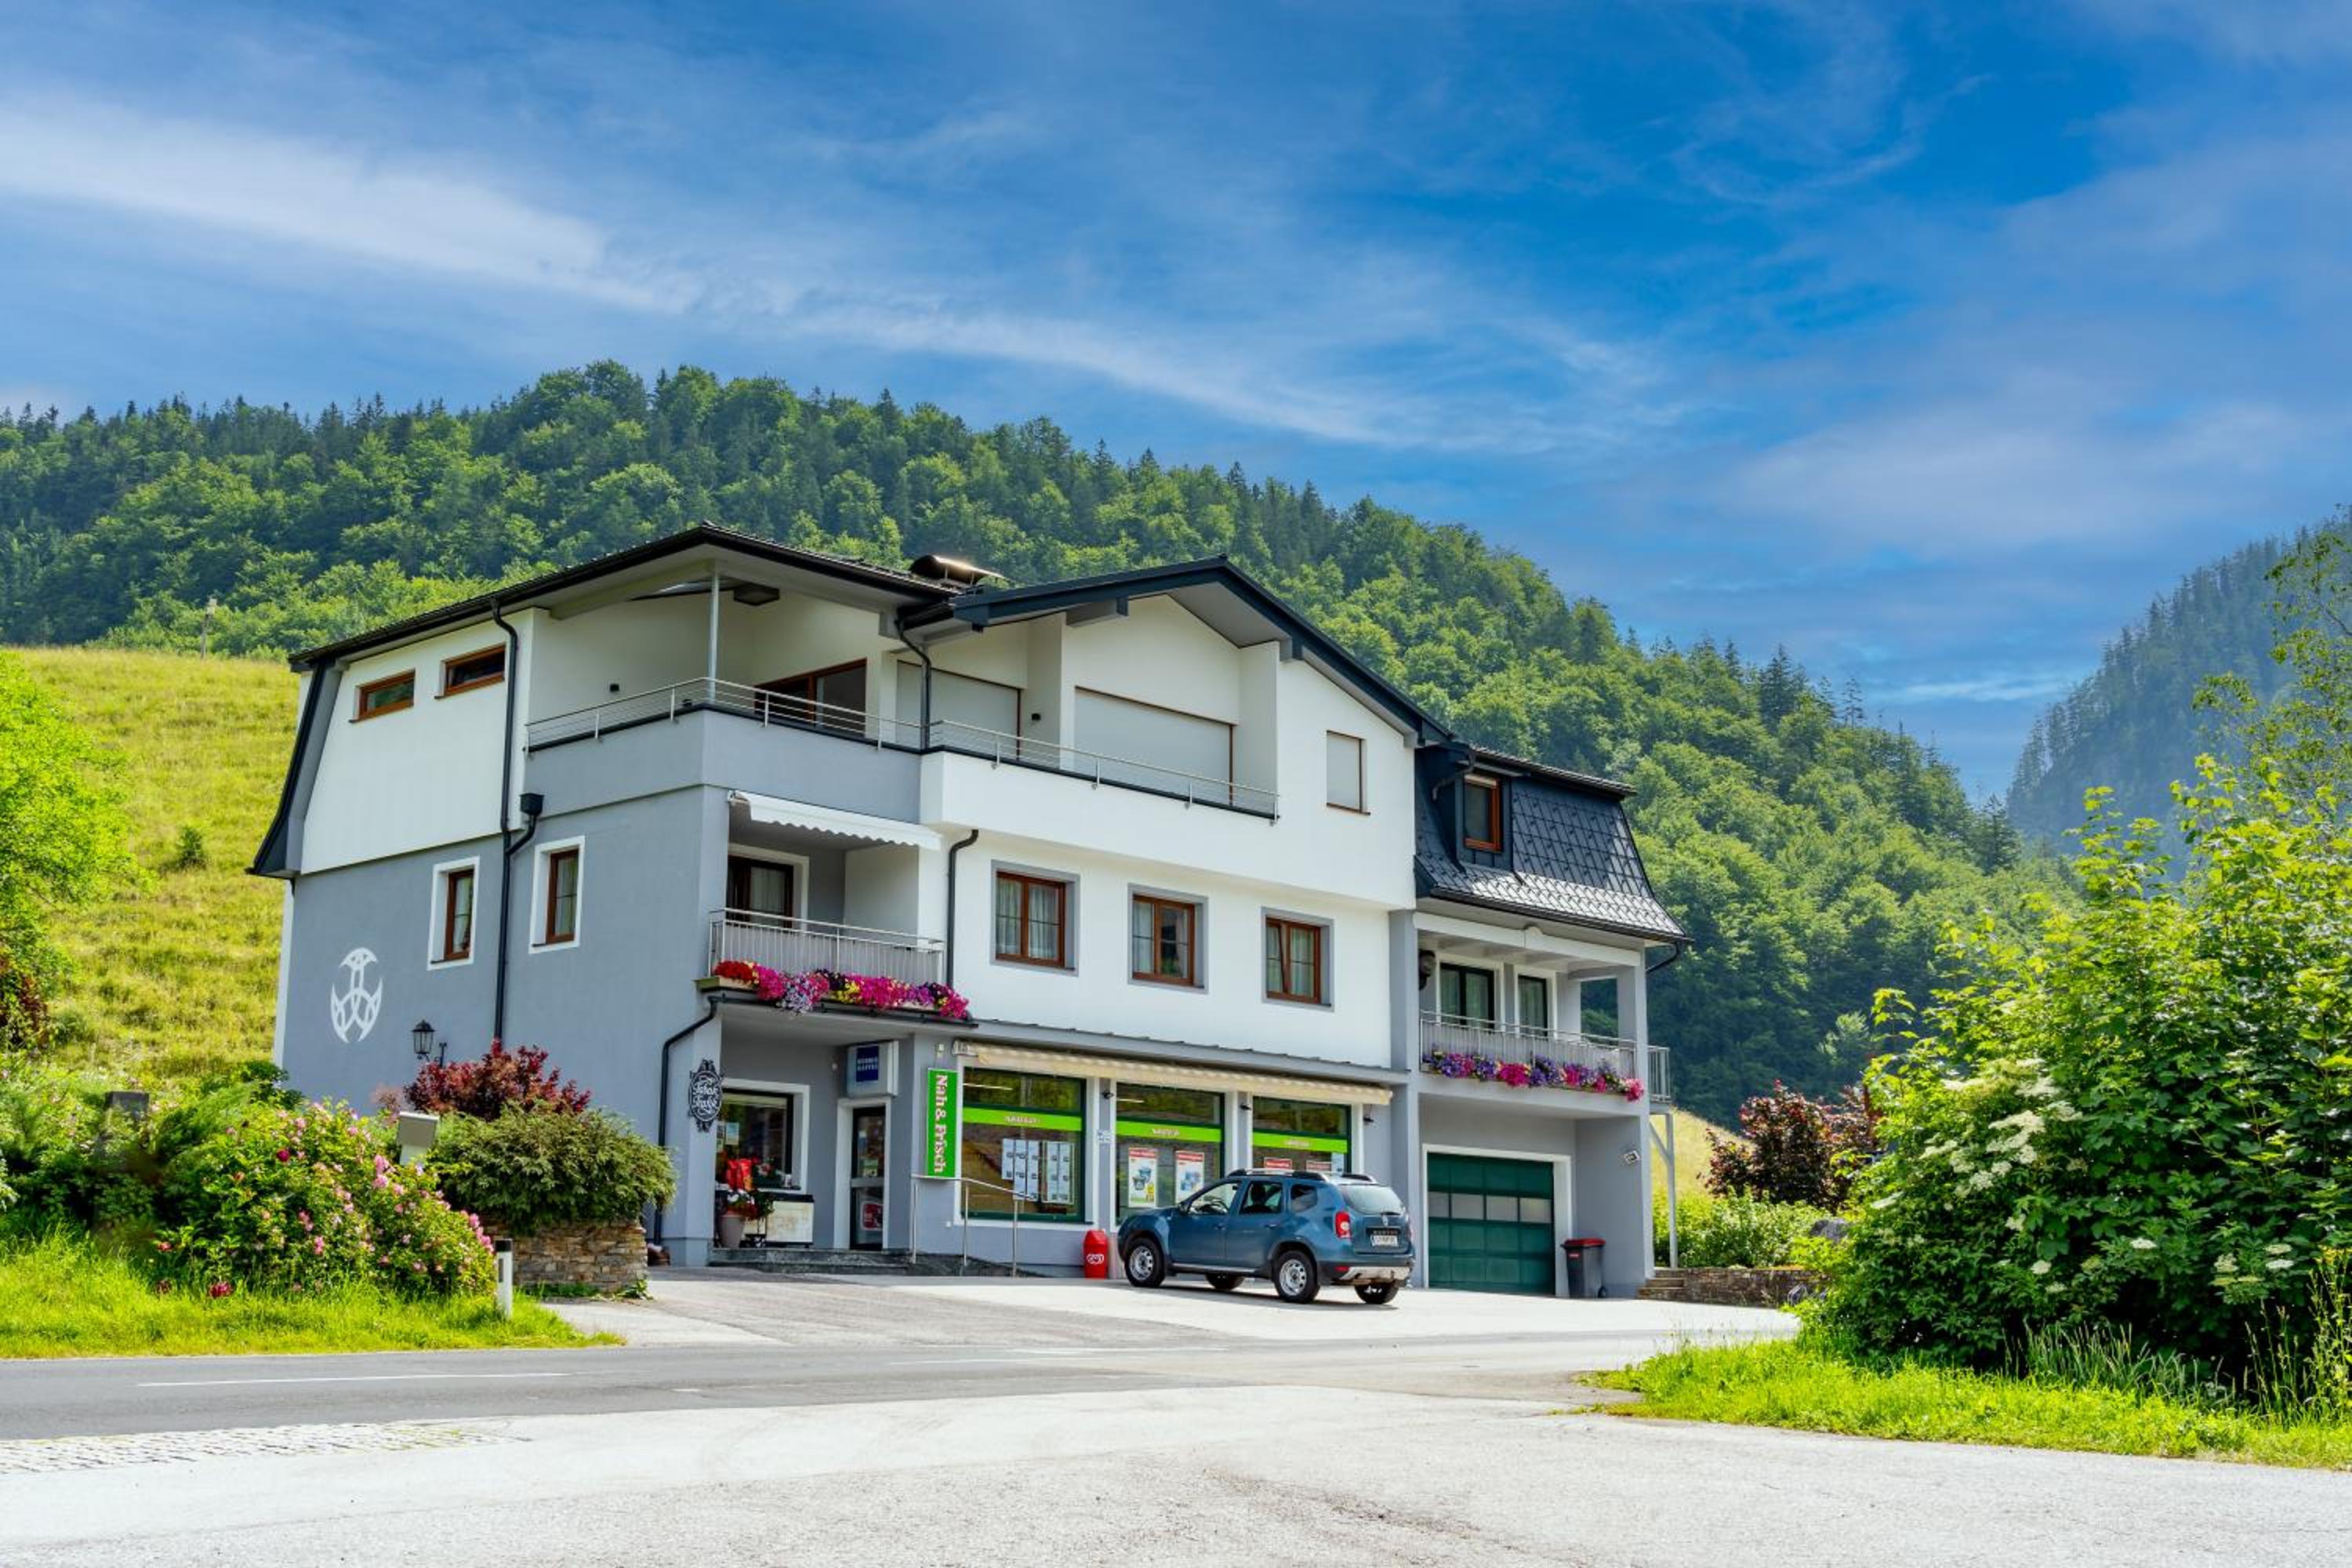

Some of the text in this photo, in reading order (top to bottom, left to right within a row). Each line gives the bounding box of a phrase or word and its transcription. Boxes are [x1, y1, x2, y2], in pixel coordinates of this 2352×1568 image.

[934, 1075, 948, 1173] Nah & Frisch
